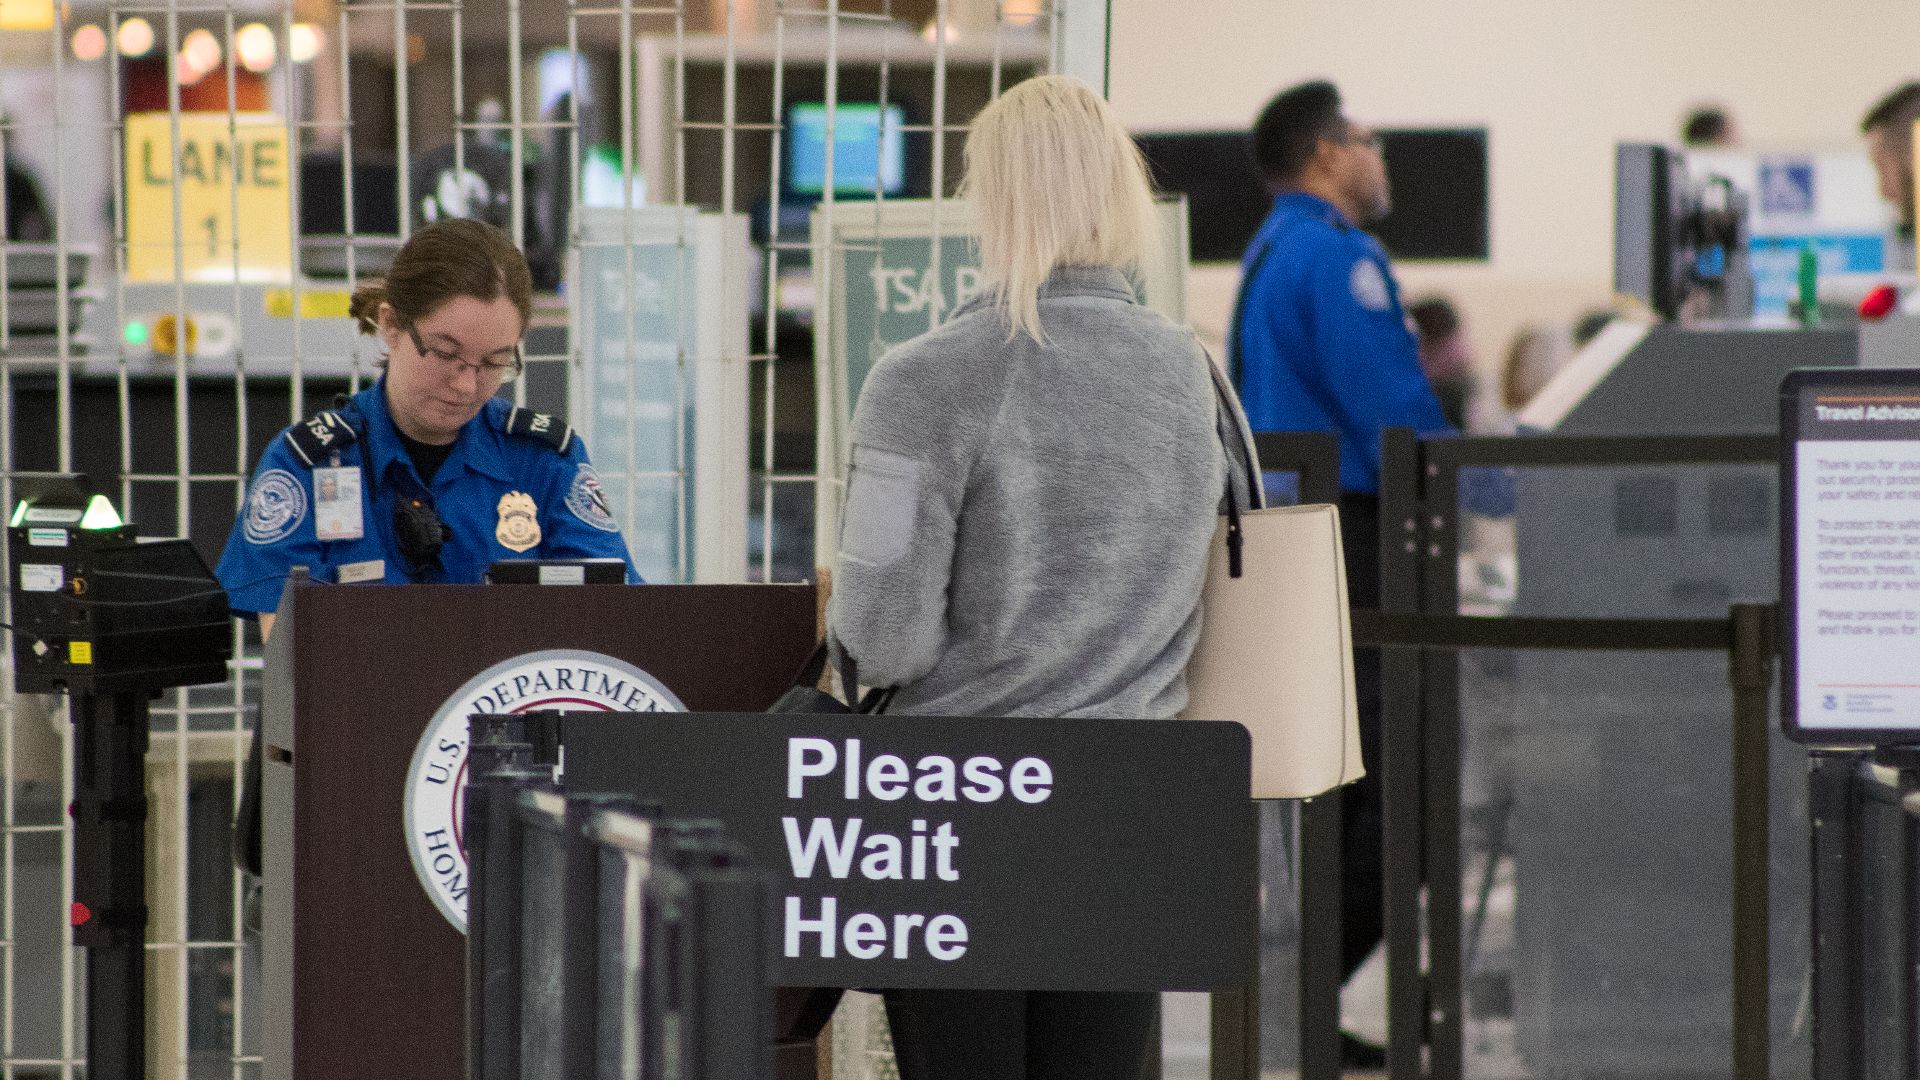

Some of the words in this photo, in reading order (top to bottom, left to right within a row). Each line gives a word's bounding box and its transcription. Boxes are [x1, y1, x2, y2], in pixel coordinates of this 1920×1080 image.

[142, 139, 281, 187] LANE
[203, 215, 217, 257] 1
[868, 267, 946, 313] TSA
[1815, 404, 1864, 421] Travel
[305, 415, 335, 447] TSA
[529, 413, 552, 433] TSA
[1817, 458, 1850, 471] Thank
[1854, 461, 1876, 473] you
[1878, 458, 1894, 471] for
[1838, 474, 1882, 488] security
[1817, 490, 1842, 503] your
[1846, 488, 1880, 502] safety
[1883, 489, 1905, 501] and
[1834, 520, 1873, 532] protect
[1876, 518, 1894, 530] the
[1817, 534, 1899, 546] Transportation
[1818, 549, 1846, 560] other
[1850, 549, 1911, 561] individuals
[1817, 579, 1864, 590] violence
[1867, 578, 1879, 590] of
[1882, 580, 1903, 592] any
[1817, 608, 1853, 621] Please
[1857, 609, 1902, 622] proceed
[1817, 623, 1839, 635] and
[1842, 623, 1873, 635] thank
[1877, 625, 1898, 637] you
[426, 737, 466, 785] U.S.
[787, 737, 1053, 803] Please
[781, 817, 960, 882] Wait
[424, 828, 468, 913] HOM
[784, 896, 969, 961] Here
